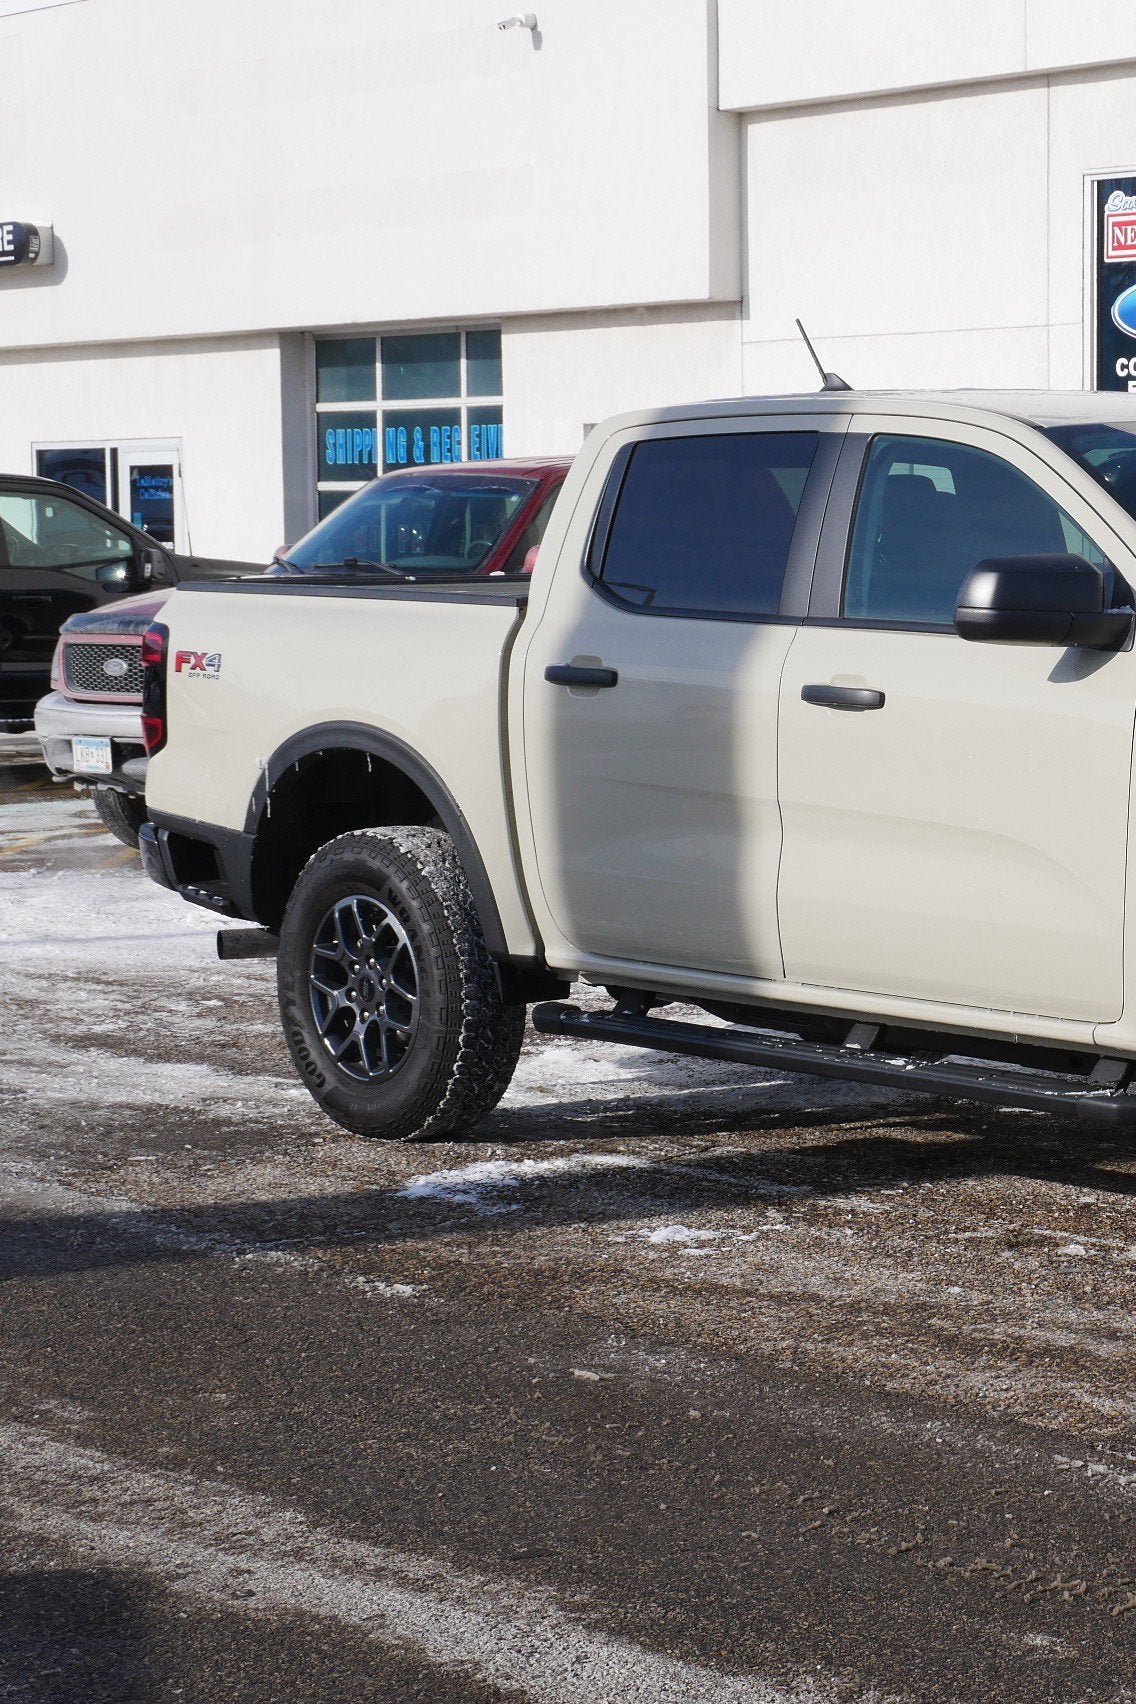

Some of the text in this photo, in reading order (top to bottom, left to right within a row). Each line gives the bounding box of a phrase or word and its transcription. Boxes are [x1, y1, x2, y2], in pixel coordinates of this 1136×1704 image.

[325, 427, 407, 465] SHIPPING
[413, 426, 425, 464] &
[175, 650, 222, 673] FX4
